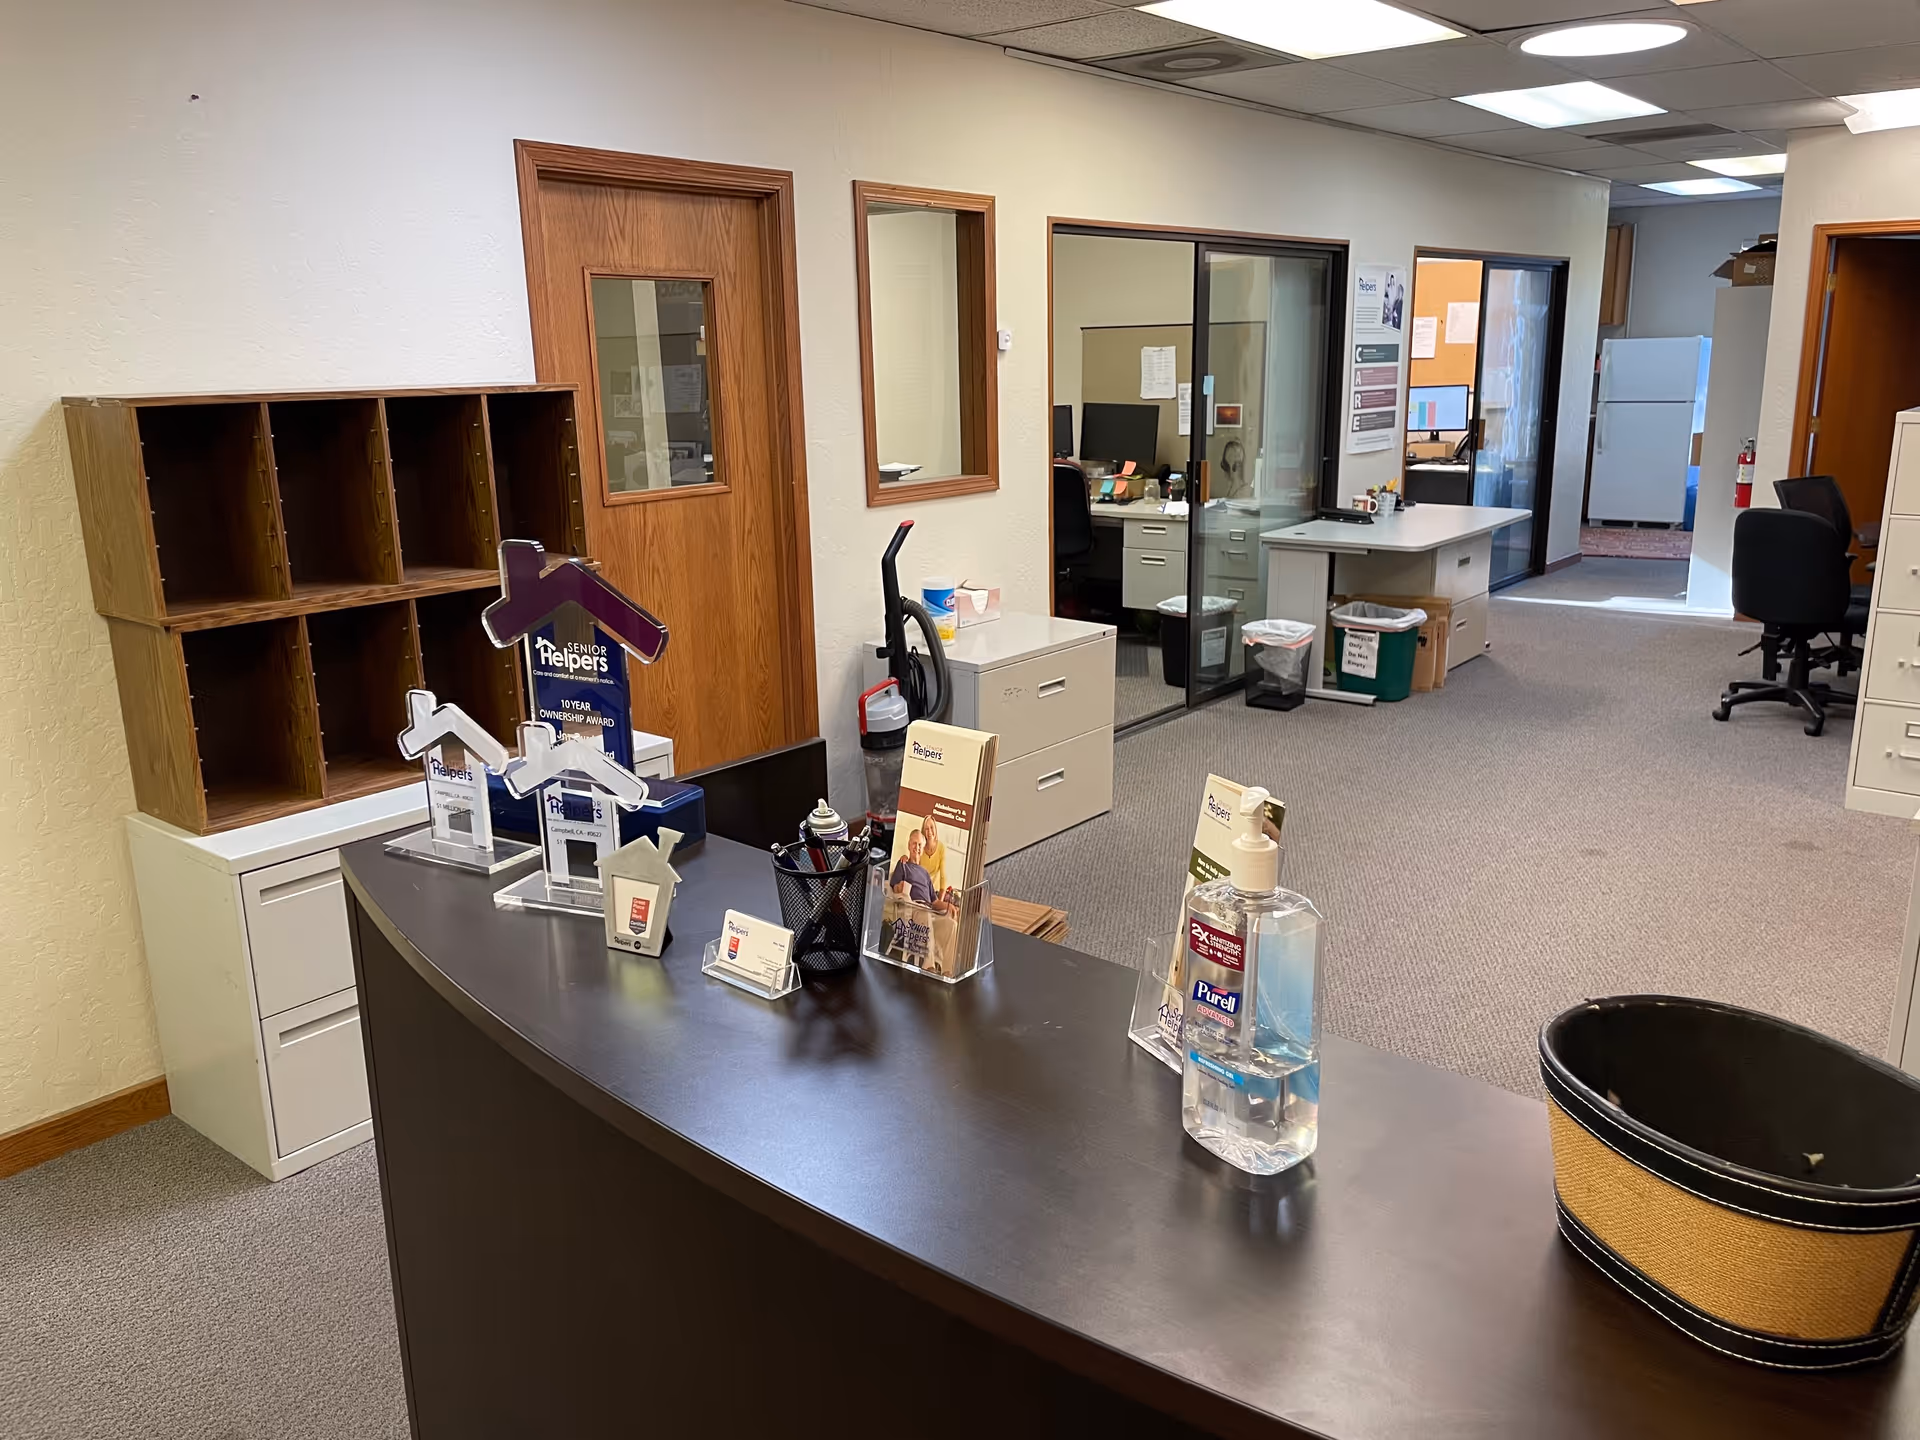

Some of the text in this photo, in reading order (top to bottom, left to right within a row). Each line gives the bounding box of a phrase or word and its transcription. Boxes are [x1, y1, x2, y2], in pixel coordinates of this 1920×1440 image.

[1356, 347, 1362, 362] C
[1355, 371, 1361, 385] A
[1354, 393, 1361, 408] R
[1353, 416, 1360, 430] E
[568, 642, 607, 656] SENIOR
[1348, 642, 1363, 650] Only
[540, 647, 608, 672] Helpers
[1347, 660, 1366, 669] Empty
[561, 699, 591, 711] 10 YEAR
[540, 709, 615, 728] OWNERSHIP AWARD
[913, 745, 942, 760] Helpers
[433, 763, 473, 781] Helpers
[1208, 800, 1231, 821] Helpers
[551, 827, 575, 836] Campbell,
[1191, 923, 1210, 945] 2X
[1197, 981, 1236, 1013] Purell
[1197, 1004, 1235, 1027] ADVANCED
